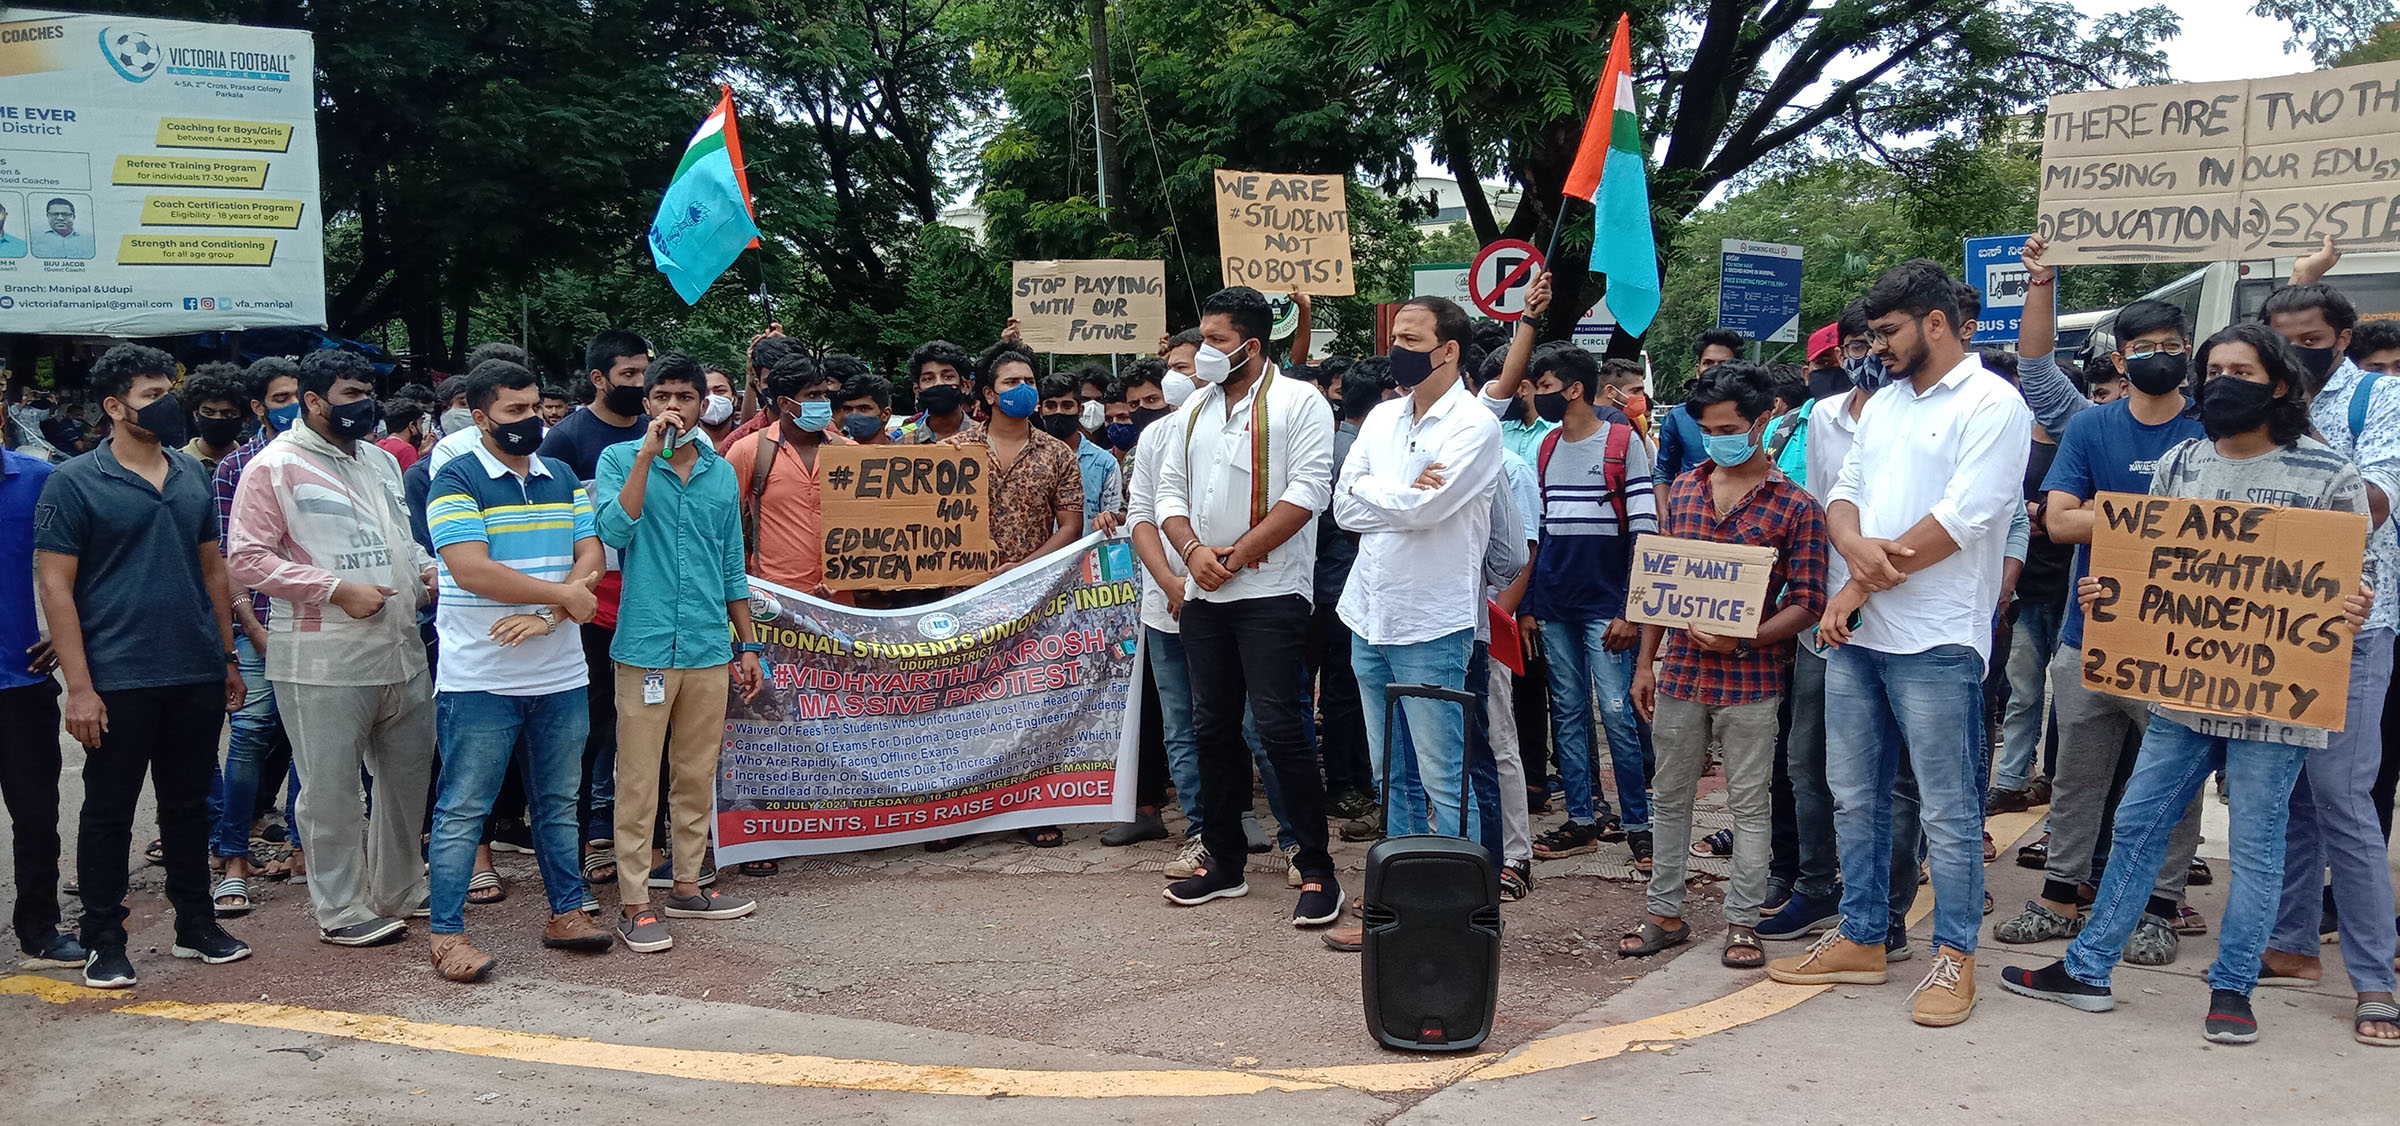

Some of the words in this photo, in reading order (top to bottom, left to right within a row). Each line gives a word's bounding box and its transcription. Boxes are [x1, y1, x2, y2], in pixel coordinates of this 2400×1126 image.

[2, 25, 64, 44] COACHES
[169, 47, 227, 69] VICTORIA
[231, 83, 255, 92] Prasad
[257, 85, 282, 94] Colony
[25, 107, 77, 122] EVER
[2048, 102, 2157, 143] THERE
[2161, 93, 2240, 137] ARE
[2255, 86, 2344, 132] TWO
[2, 122, 63, 136] District
[166, 122, 214, 134] Coaching
[217, 125, 230, 133] for
[233, 126, 283, 136] Boys/Girls
[176, 133, 215, 142] between
[253, 138, 276, 146] years
[126, 159, 167, 169] Referee
[168, 161, 211, 171] Training
[213, 163, 257, 174] Program
[152, 172, 201, 181] individuals
[202, 174, 223, 182] 17-30
[2044, 161, 2177, 191] MISSING
[2199, 156, 2235, 188] IN
[2242, 152, 2299, 182] OUR
[22, 177, 60, 185] Coaches
[1216, 175, 1259, 202] WE
[1266, 178, 1330, 202] ARE
[153, 200, 185, 209] Coach
[187, 200, 250, 210] Certification
[252, 203, 294, 214] Program
[170, 210, 211, 220] Eligibility
[229, 213, 251, 221] years
[263, 214, 280, 222] age
[1228, 202, 1347, 234] #STUDENT
[131, 239, 177, 249] Strength
[179, 240, 199, 248] and
[201, 240, 265, 250] Conditioning
[1265, 232, 1320, 256] NOT
[1226, 254, 1344, 287] ROBOTS!
[4, 284, 47, 293] Branch:
[49, 284, 91, 295] Manipal
[1015, 275, 1066, 298] STOP
[1074, 275, 1164, 298] PLAYING
[235, 299, 293, 310] vfa_manipal
[1029, 298, 1074, 315] WITH
[1092, 297, 1128, 317] OUR
[1068, 318, 1138, 342] FUTURE
[1976, 320, 2005, 332] BUS
[1582, 338, 1610, 346] CIRCLE
[828, 456, 981, 499] #ERROR
[936, 497, 980, 523] 404
[2102, 500, 2170, 540] WE
[2176, 505, 2276, 543] ARE
[824, 523, 962, 555] EDUCATION
[824, 553, 913, 583] SYSTEM
[916, 551, 946, 572] NOT
[1643, 551, 1679, 575] WE
[1685, 558, 1743, 582] WANT
[2148, 546, 2341, 603] FIGHTING
[853, 632, 976, 661] STUDENTS
[979, 608, 1042, 646] UNION
[1044, 592, 1068, 617] OF
[1074, 581, 1137, 612] INDIA
[2091, 576, 2121, 623] 2
[2138, 583, 2348, 654] PANDEMICS
[773, 662, 979, 693] #VIDHYARTHI
[983, 627, 1105, 678] AKROSH
[899, 656, 939, 673] UDUPI
[940, 645, 995, 668] DISTRICT
[798, 692, 937, 720] MASSIVE
[944, 660, 1082, 709] PROTEST
[735, 722, 775, 735] Waiver
[778, 724, 792, 736] Of
[796, 724, 820, 737] Fees
[824, 724, 839, 735] For
[843, 718, 889, 734] Students
[891, 718, 916, 729] Who
[918, 707, 990, 727] Unfortunately
[994, 702, 1018, 716] Lost
[1020, 700, 1041, 711] The
[1043, 693, 1069, 707] Head
[1071, 690, 1084, 701] Of
[735, 739, 811, 753] Cancellation
[815, 741, 830, 753] Of
[832, 740, 868, 753] Exams
[871, 738, 889, 749] For
[946, 725, 986, 743] Degree
[989, 722, 1012, 734] And
[1015, 708, 1080, 730] Engineering
[1082, 699, 1127, 714] Students
[735, 769, 788, 782] Incresed
[791, 771, 836, 782] Burden
[840, 771, 857, 782] On
[861, 767, 911, 782] Students
[914, 762, 937, 777] Due
[939, 761, 954, 772] To
[956, 754, 1005, 770] Increase
[1007, 750, 1018, 761] In
[1020, 745, 1042, 758] Fuel
[1044, 736, 1075, 749] Prices
[1077, 730, 1112, 742] Which
[735, 754, 763, 767] Who
[766, 756, 787, 767] Are
[791, 756, 838, 770] Rapidly
[840, 754, 878, 768] Facing
[880, 749, 917, 764] Offline
[921, 745, 960, 760] Exams
[735, 784, 757, 796] The
[761, 784, 811, 797] Endlead
[815, 785, 829, 796] To
[832, 784, 884, 796] Increase
[887, 783, 898, 794] In
[901, 778, 938, 793] Public
[939, 764, 1020, 788] Transportation
[1022, 758, 1045, 770] Cost
[1047, 751, 1060, 764] By
[1063, 745, 1087, 759] 25%
[766, 801, 781, 811] 20
[783, 800, 815, 811] JULY
[819, 800, 847, 810] 2021
[851, 797, 910, 808] TUESDAY
[912, 795, 926, 805] @
[929, 789, 958, 802] 10.30
[985, 776, 1020, 792] TIGER
[1021, 764, 1061, 783] CIRCLE
[1062, 760, 1115, 773] MANIPAL
[743, 814, 868, 835] STUDENTS,
[873, 809, 928, 829] LETS
[933, 798, 995, 823] RAISE
[999, 784, 1042, 808] OUR
